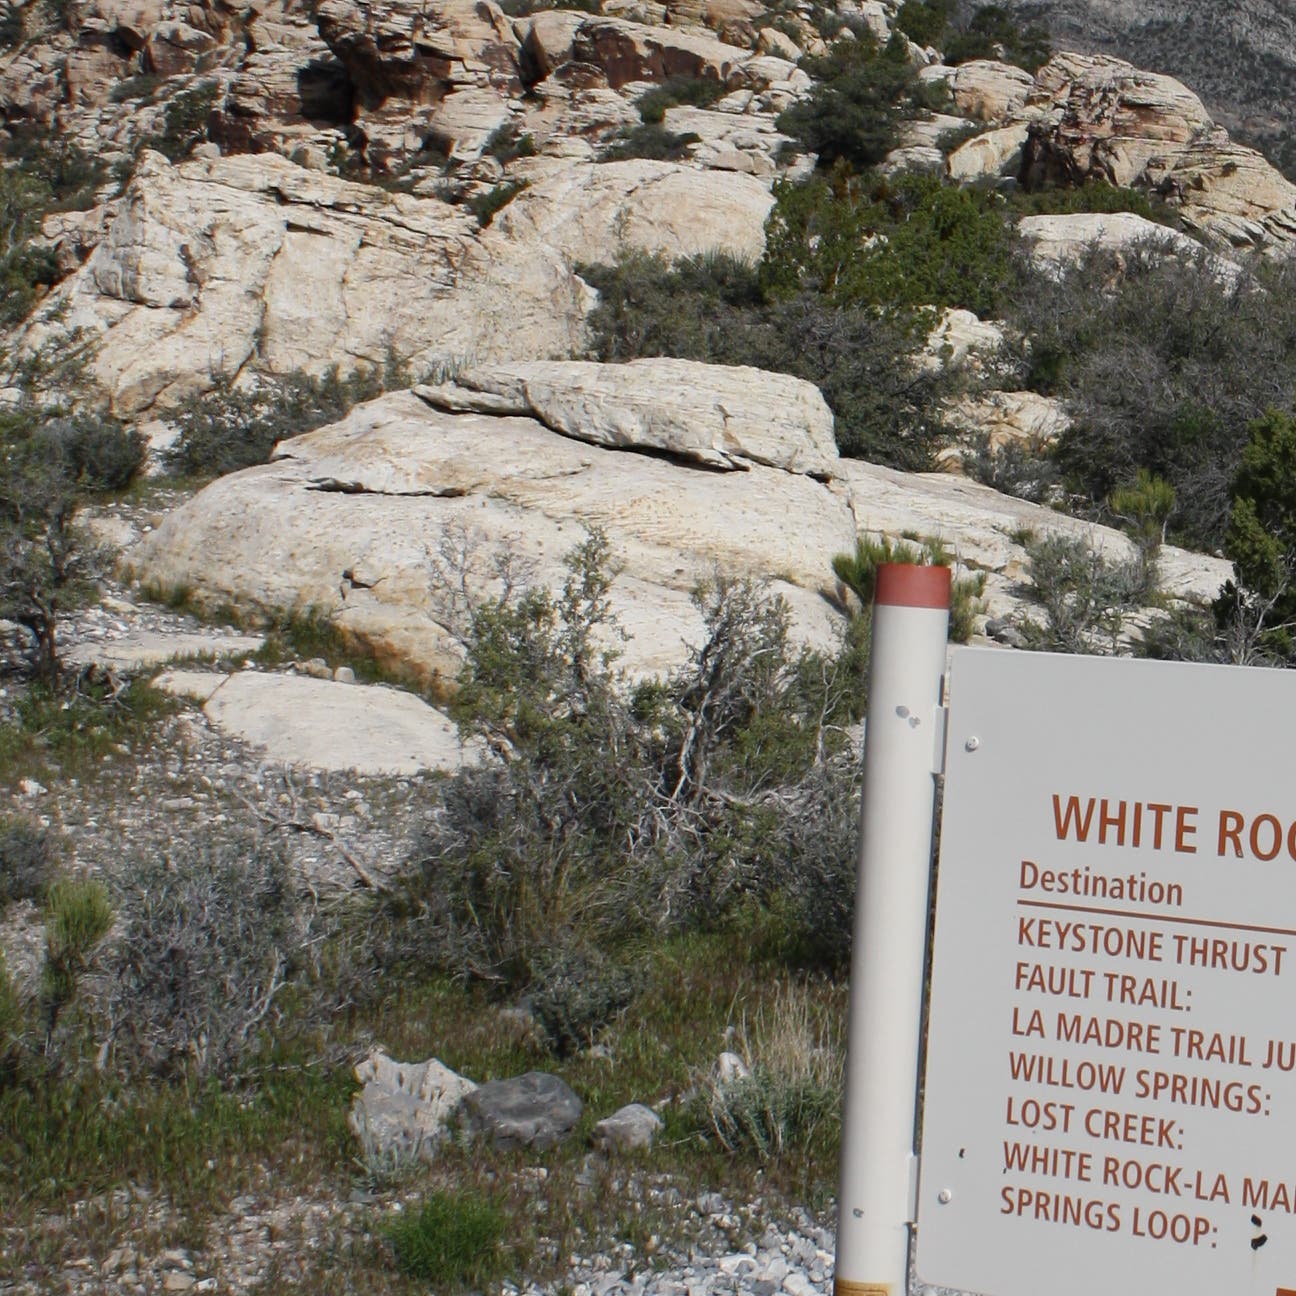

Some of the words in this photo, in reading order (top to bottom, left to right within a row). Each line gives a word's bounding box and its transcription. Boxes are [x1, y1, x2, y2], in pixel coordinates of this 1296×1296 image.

[1053, 793, 1199, 854] WHITE
[1020, 859, 1184, 905] Destination
[1019, 916, 1163, 961] KEYSTONE
[1176, 933, 1286, 975] THRUST
[1016, 960, 1095, 998] FAULT
[1105, 971, 1194, 1011] TRAIL:
[1014, 1007, 1047, 1038] LA
[1058, 1011, 1160, 1054] MADRE
[1172, 1025, 1251, 1066] TRAIL
[1010, 1051, 1127, 1094] WILLOW
[1137, 1068, 1270, 1115] SPRINGS:
[1008, 1096, 1075, 1131] LOST
[1085, 1107, 1185, 1149] CREEK:
[1004, 1140, 1093, 1182] WHITE
[1104, 1154, 1231, 1201] ROCK-LA
[1002, 1185, 1122, 1232] SPRINGS
[1133, 1206, 1218, 1248] LOOP:
